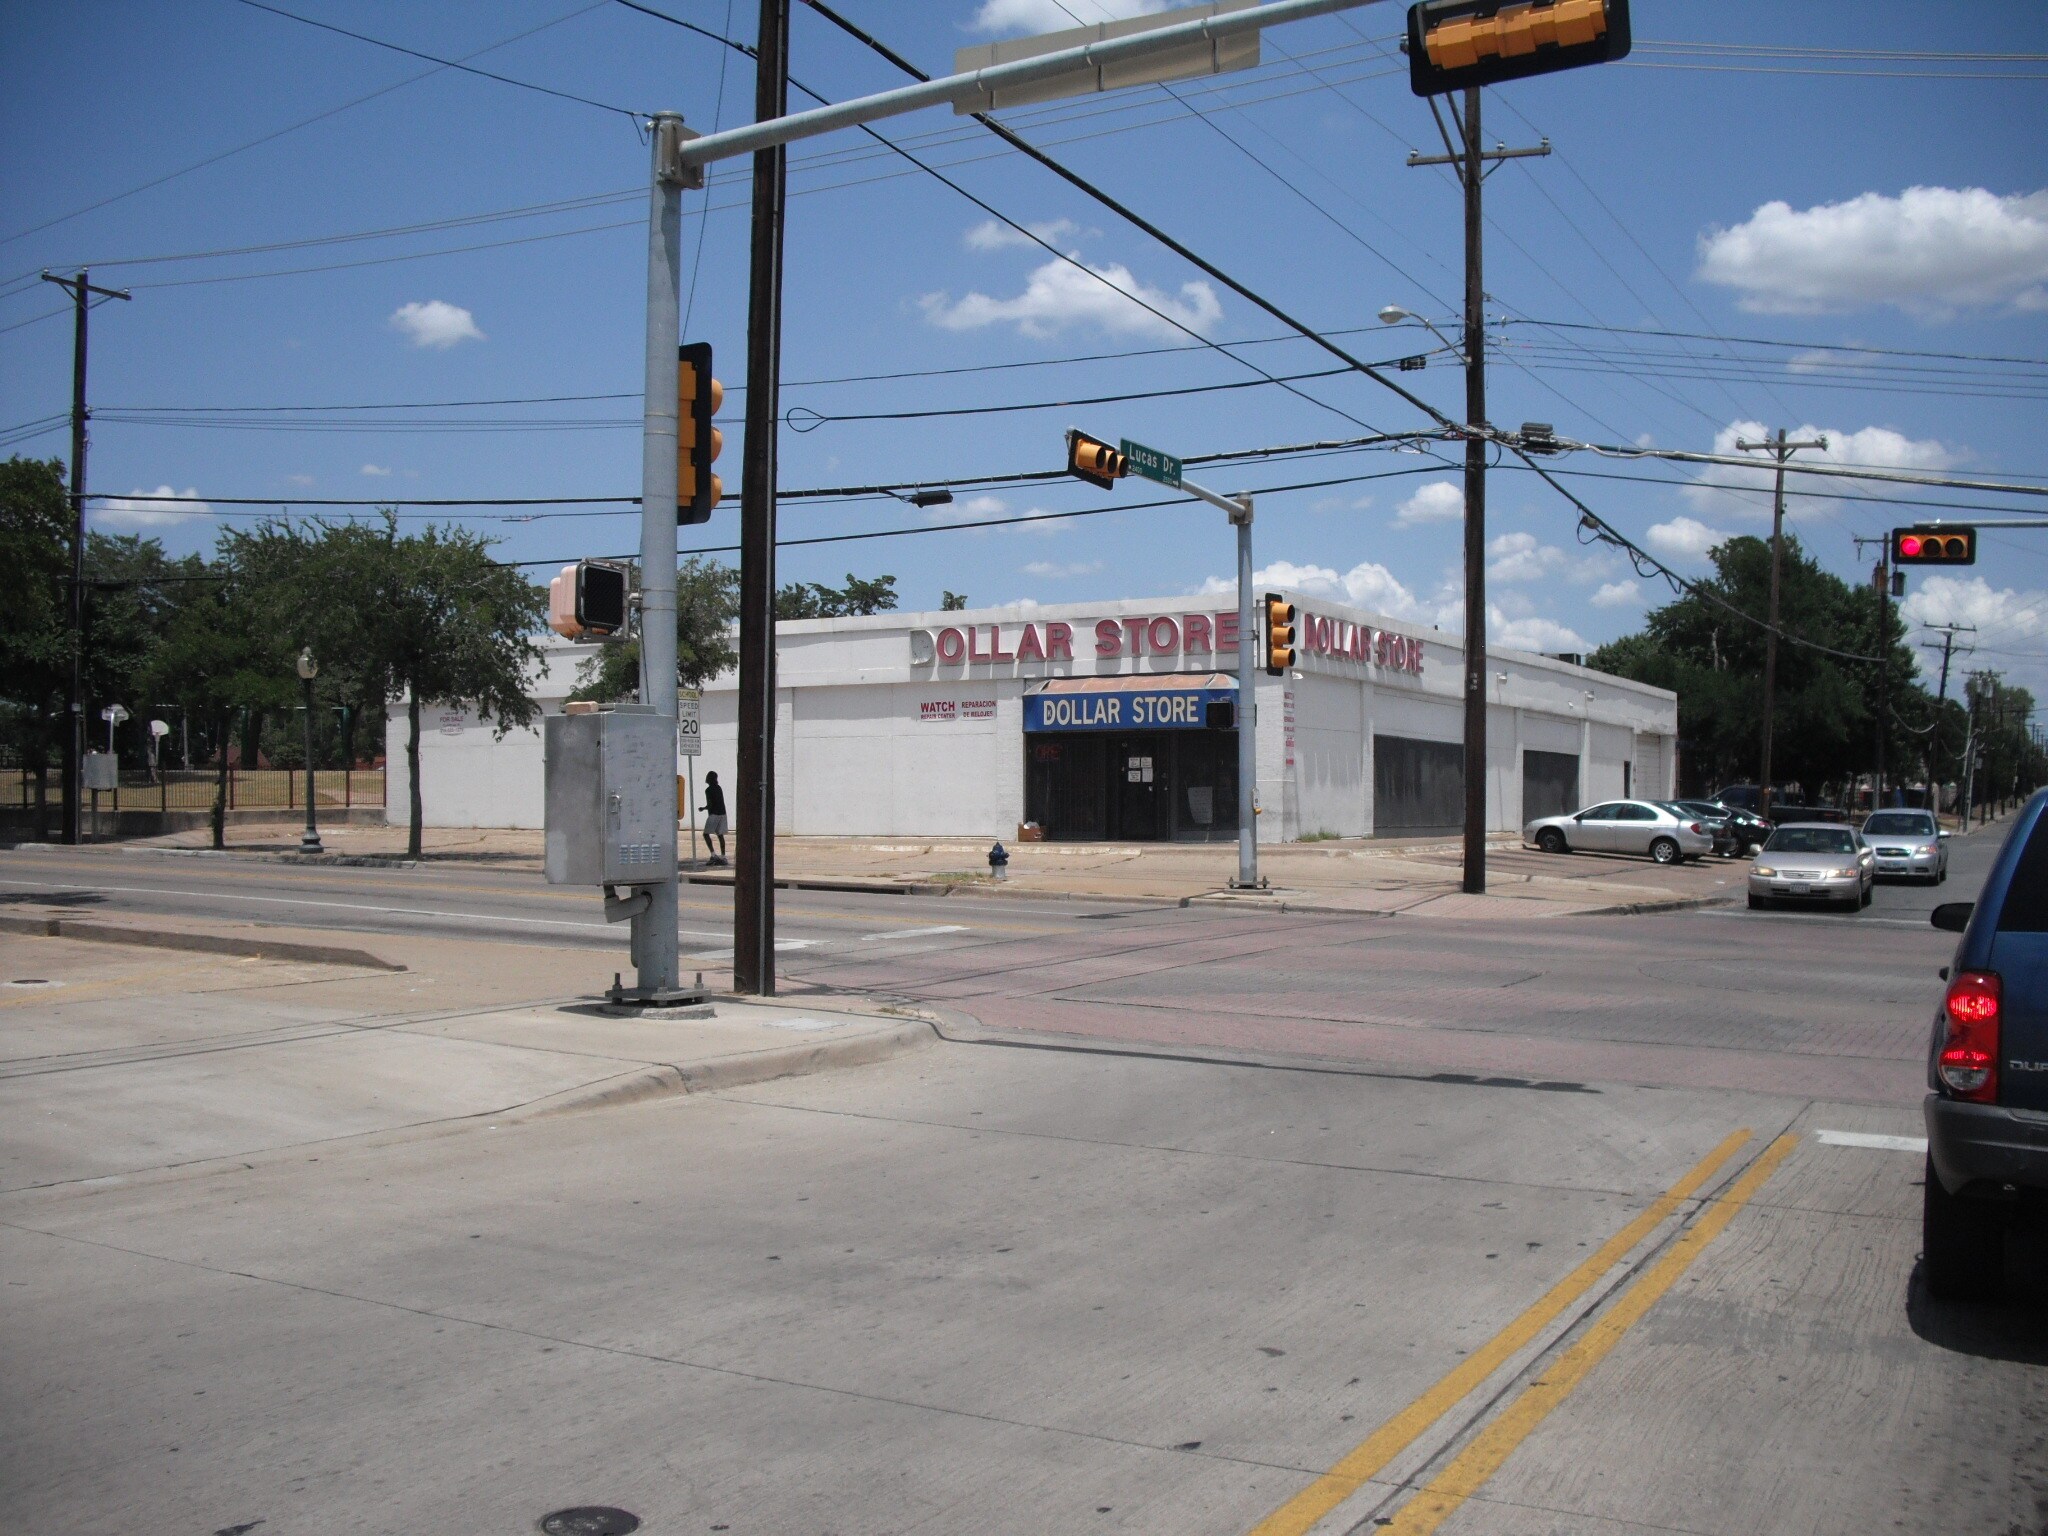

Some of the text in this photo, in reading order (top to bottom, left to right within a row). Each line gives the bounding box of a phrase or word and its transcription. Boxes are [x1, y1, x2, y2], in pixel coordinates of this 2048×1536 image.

[1129, 443, 1176, 475] Lucas Dr.
[910, 612, 1239, 665] DOLLAR STORE
[1304, 613, 1424, 673] DOLLAR STORE
[679, 690, 698, 699] SCHOOL
[679, 702, 698, 710] SPEED
[921, 701, 956, 713] WATCH
[961, 700, 997, 709] REPARACION
[1043, 696, 1199, 726] DOLLAR STORE
[971, 710, 993, 718] RELOJES
[682, 719, 698, 734] 20
